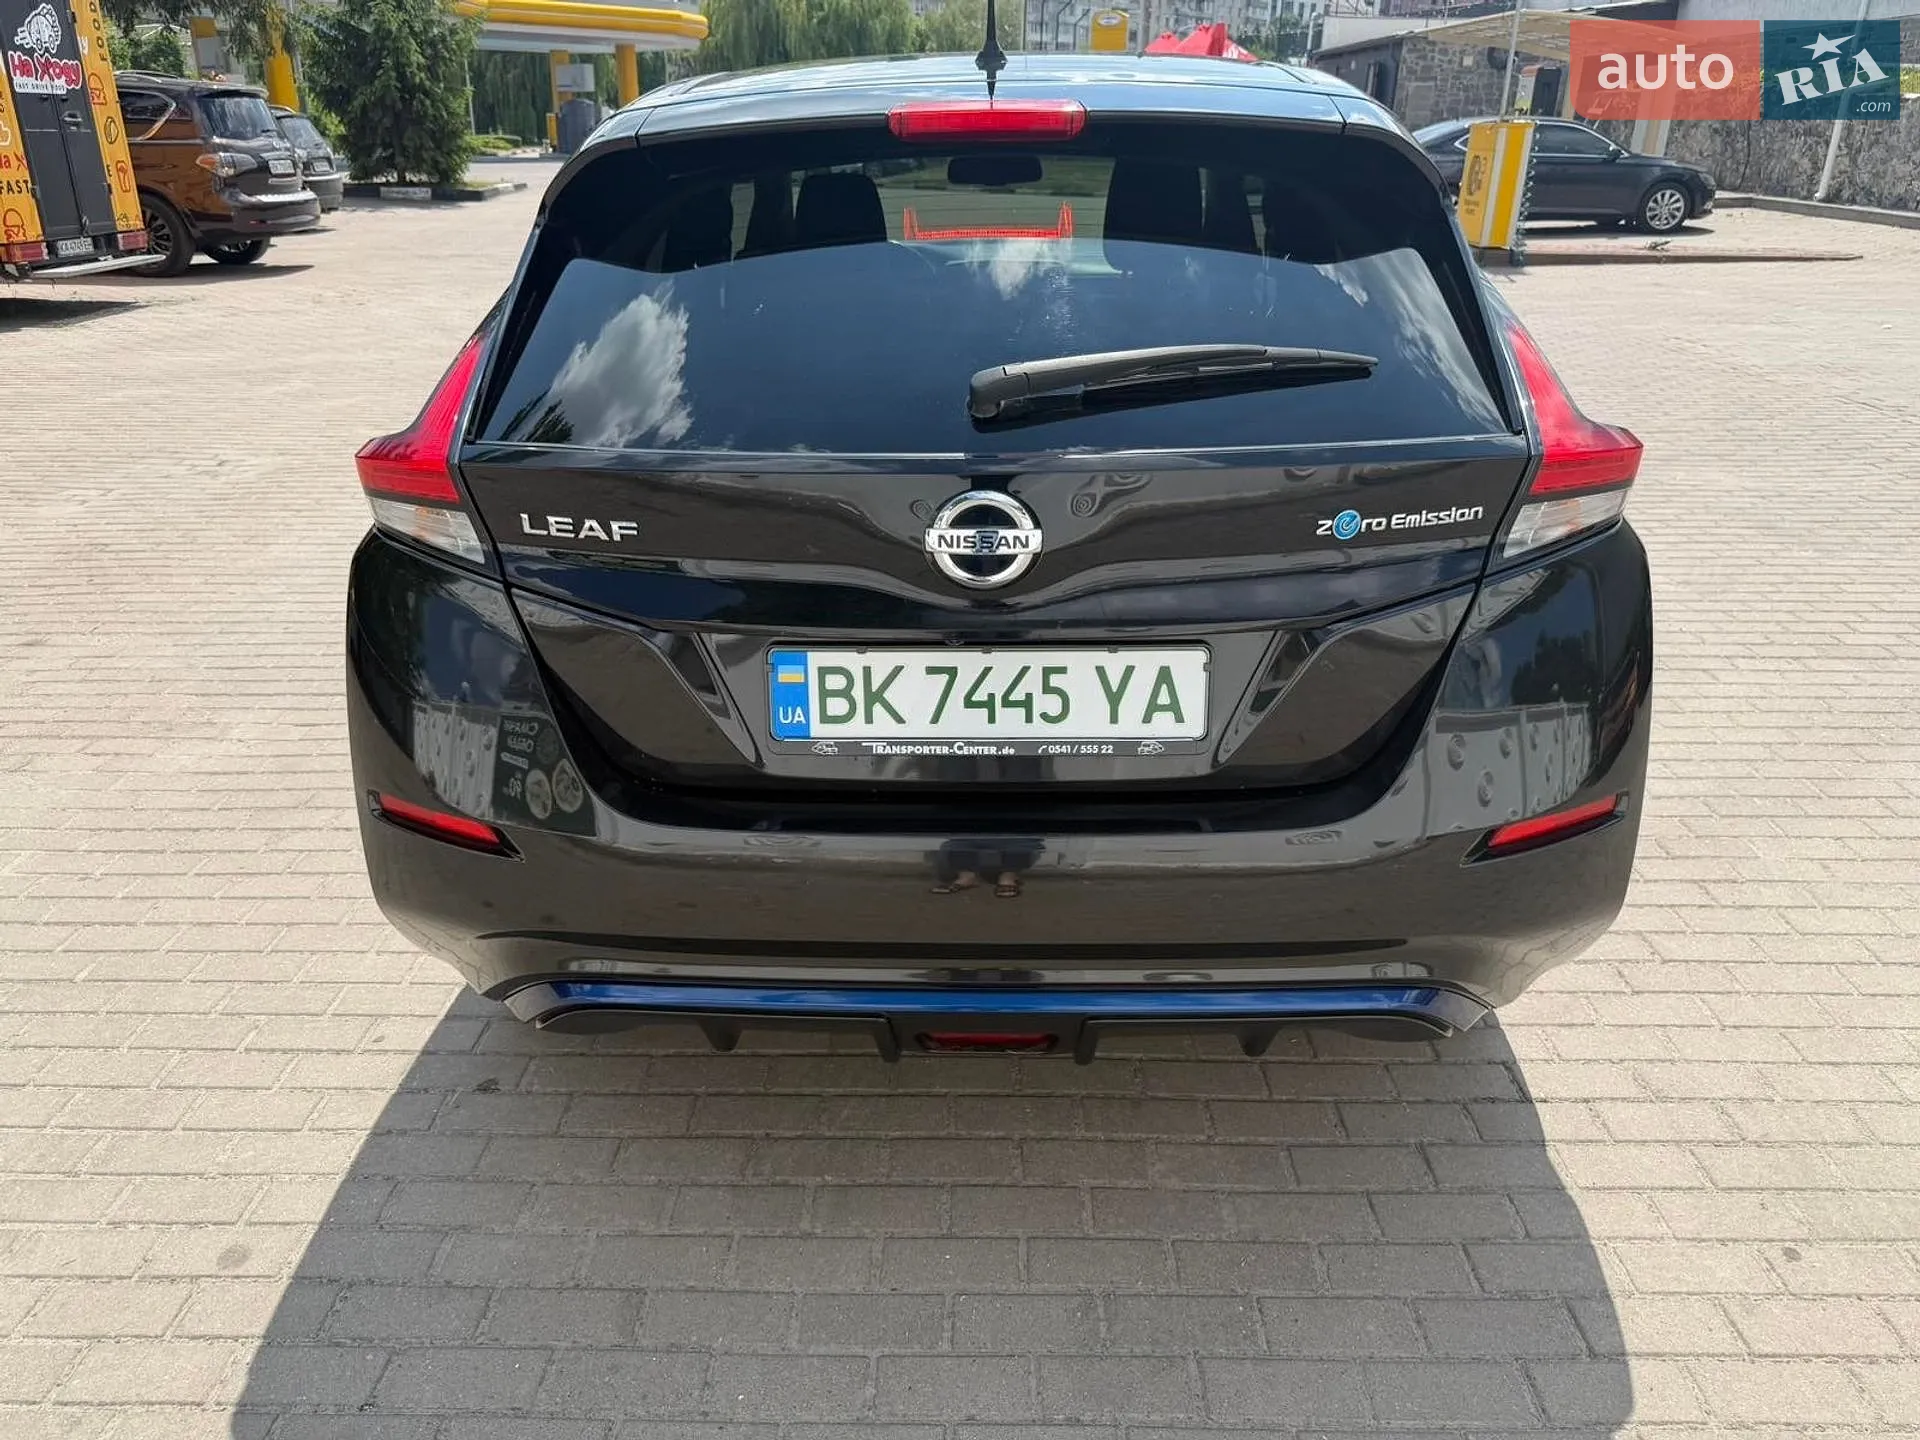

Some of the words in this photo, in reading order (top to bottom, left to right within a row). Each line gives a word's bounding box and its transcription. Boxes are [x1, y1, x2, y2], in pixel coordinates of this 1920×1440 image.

[520, 513, 638, 541] LEAF
[1391, 505, 1484, 529] Emission
[937, 535, 1030, 549] NISSAN
[817, 665, 906, 725] BK
[925, 665, 1071, 725] 7445
[1095, 665, 1186, 724] YA
[779, 706, 806, 725] UA
[1047, 744, 1071, 755] 0541
[1080, 744, 1099, 755] 555
[1100, 744, 1114, 754] 22
